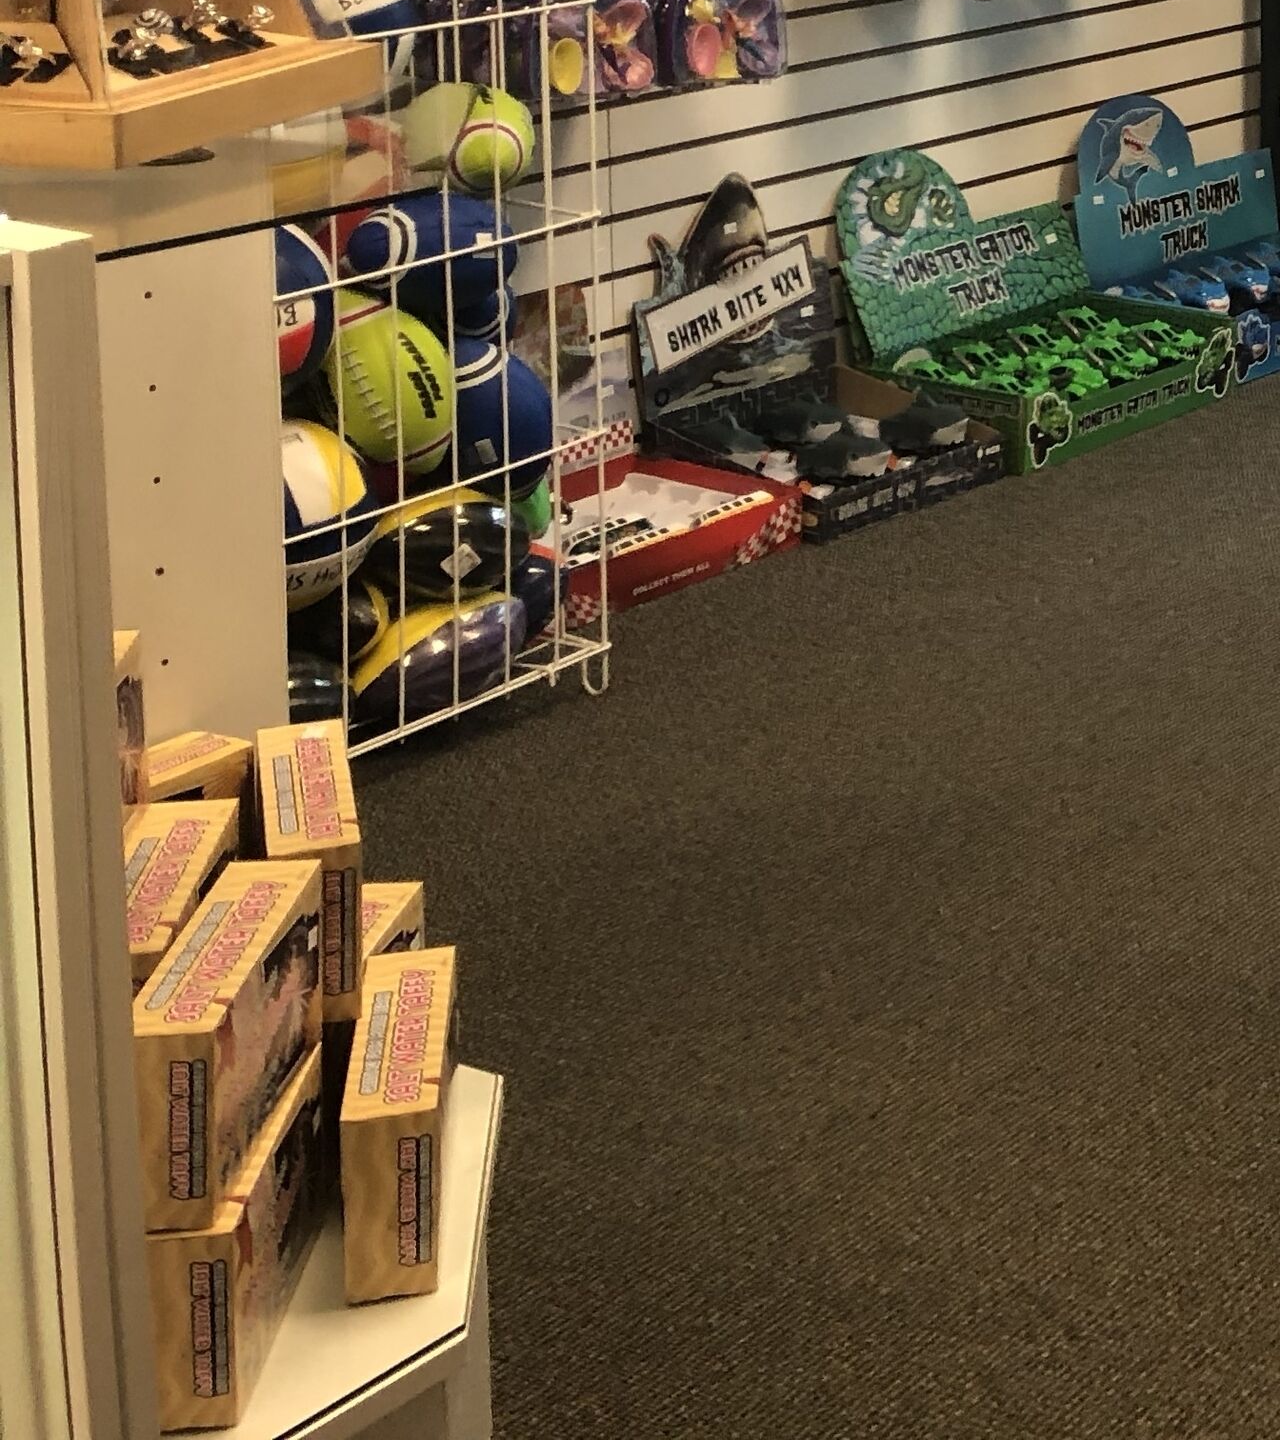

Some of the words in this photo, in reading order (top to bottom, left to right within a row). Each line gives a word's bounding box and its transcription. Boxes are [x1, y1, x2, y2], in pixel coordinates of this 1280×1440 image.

[1119, 191, 1194, 235] MONSTER
[1196, 176, 1241, 212] SHARK
[892, 241, 976, 292] MONSTER
[975, 224, 1036, 266] GATOR
[1160, 220, 1208, 260] TRUCK
[666, 307, 722, 352] SHARK
[724, 283, 767, 322] BITE
[770, 264, 805, 299] 4X4
[948, 268, 1007, 315] TRUCK
[1077, 404, 1124, 437] MONSTER
[1161, 375, 1190, 403] TRUCK
[632, 575, 670, 596] COLLECT
[165, 983, 221, 1023] SALT
[193, 926, 260, 985] WATER
[228, 880, 289, 932] TAFFY
[396, 968, 437, 1014] TAFFY
[389, 1014, 430, 1069] WATER
[383, 1068, 423, 1105] SALT
